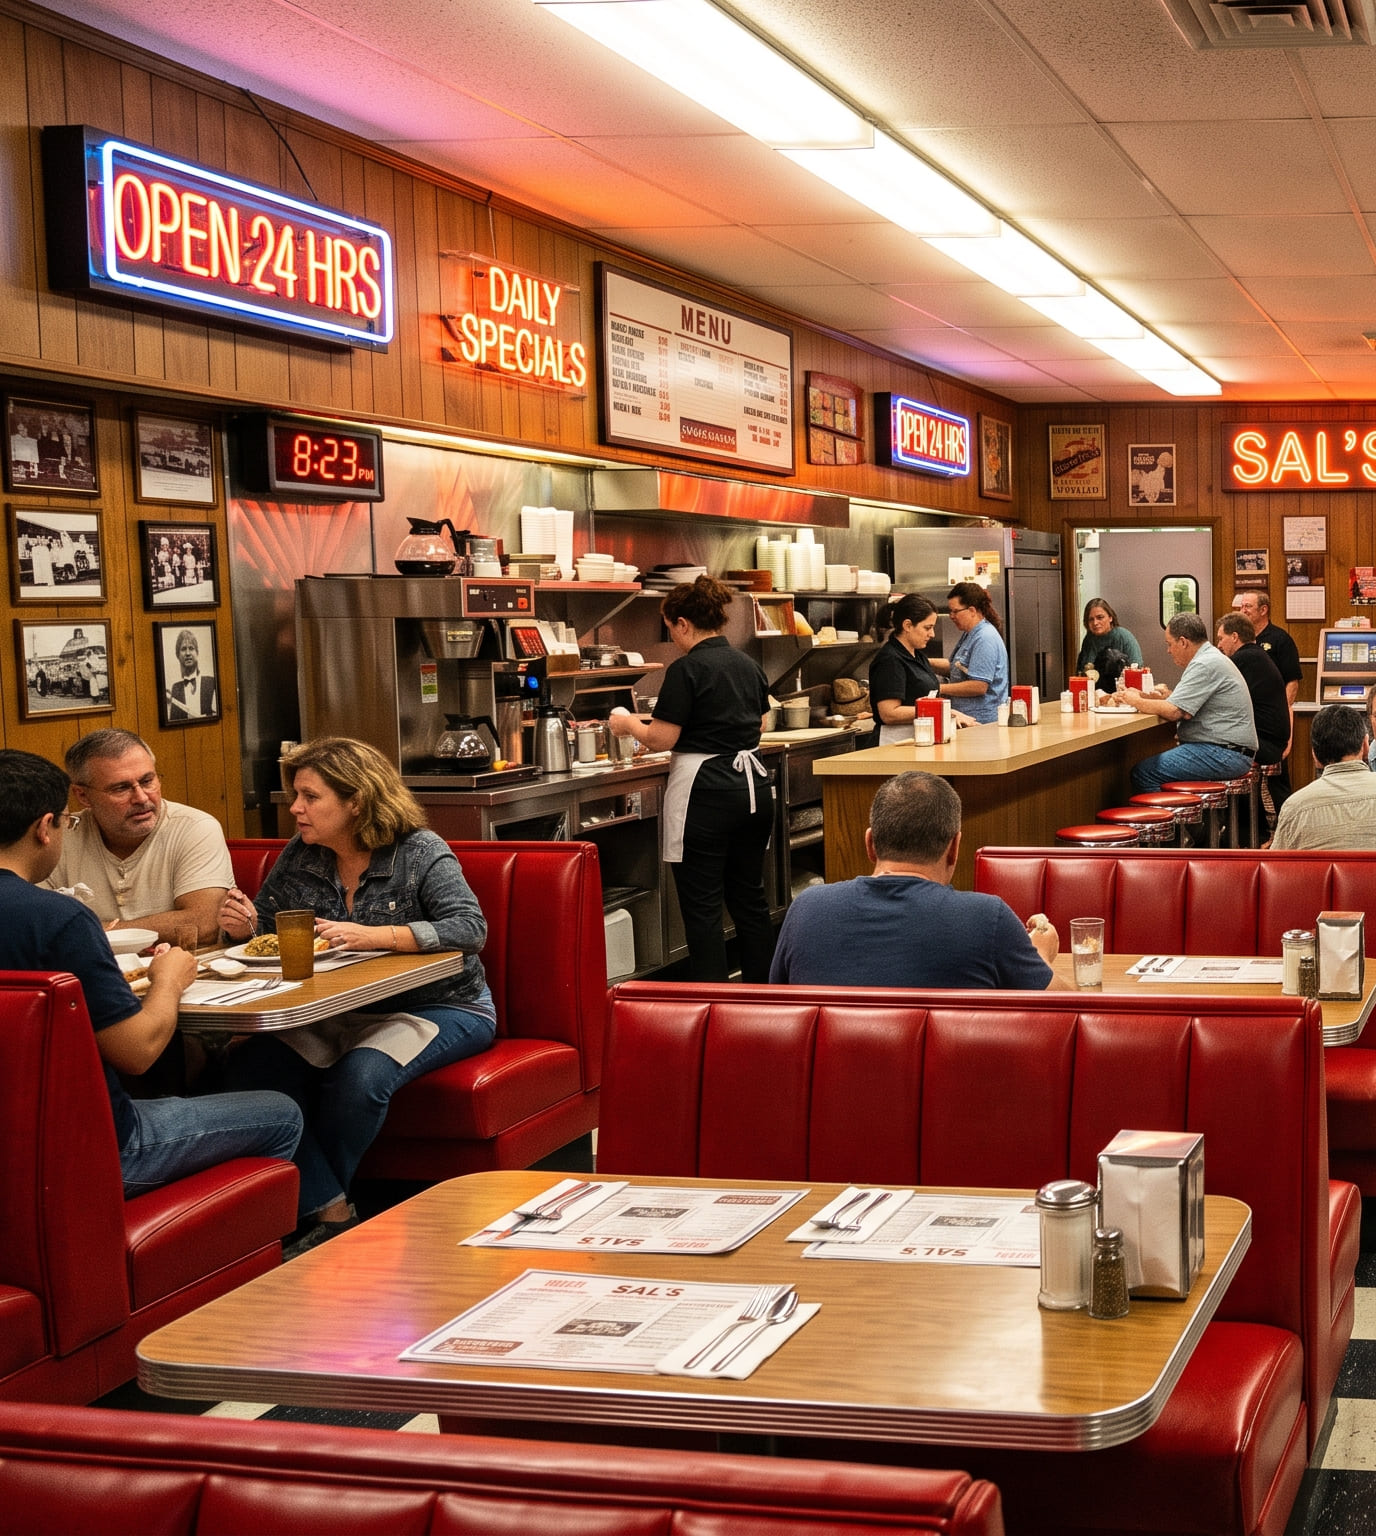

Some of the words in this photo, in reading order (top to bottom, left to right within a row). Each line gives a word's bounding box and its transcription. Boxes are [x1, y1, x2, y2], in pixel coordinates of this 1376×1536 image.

[114, 173, 241, 284] OPEN
[251, 215, 298, 298] 24
[305, 230, 382, 318] HRS
[489, 266, 561, 326] DAILY
[461, 312, 587, 387] SPECIALS
[681, 304, 732, 345] MENU
[293, 434, 358, 481] 8:23
[899, 409, 928, 455] OPEN
[929, 419, 943, 459] 24
[944, 423, 966, 465] HRS
[611, 1284, 685, 1297] SAL'S
